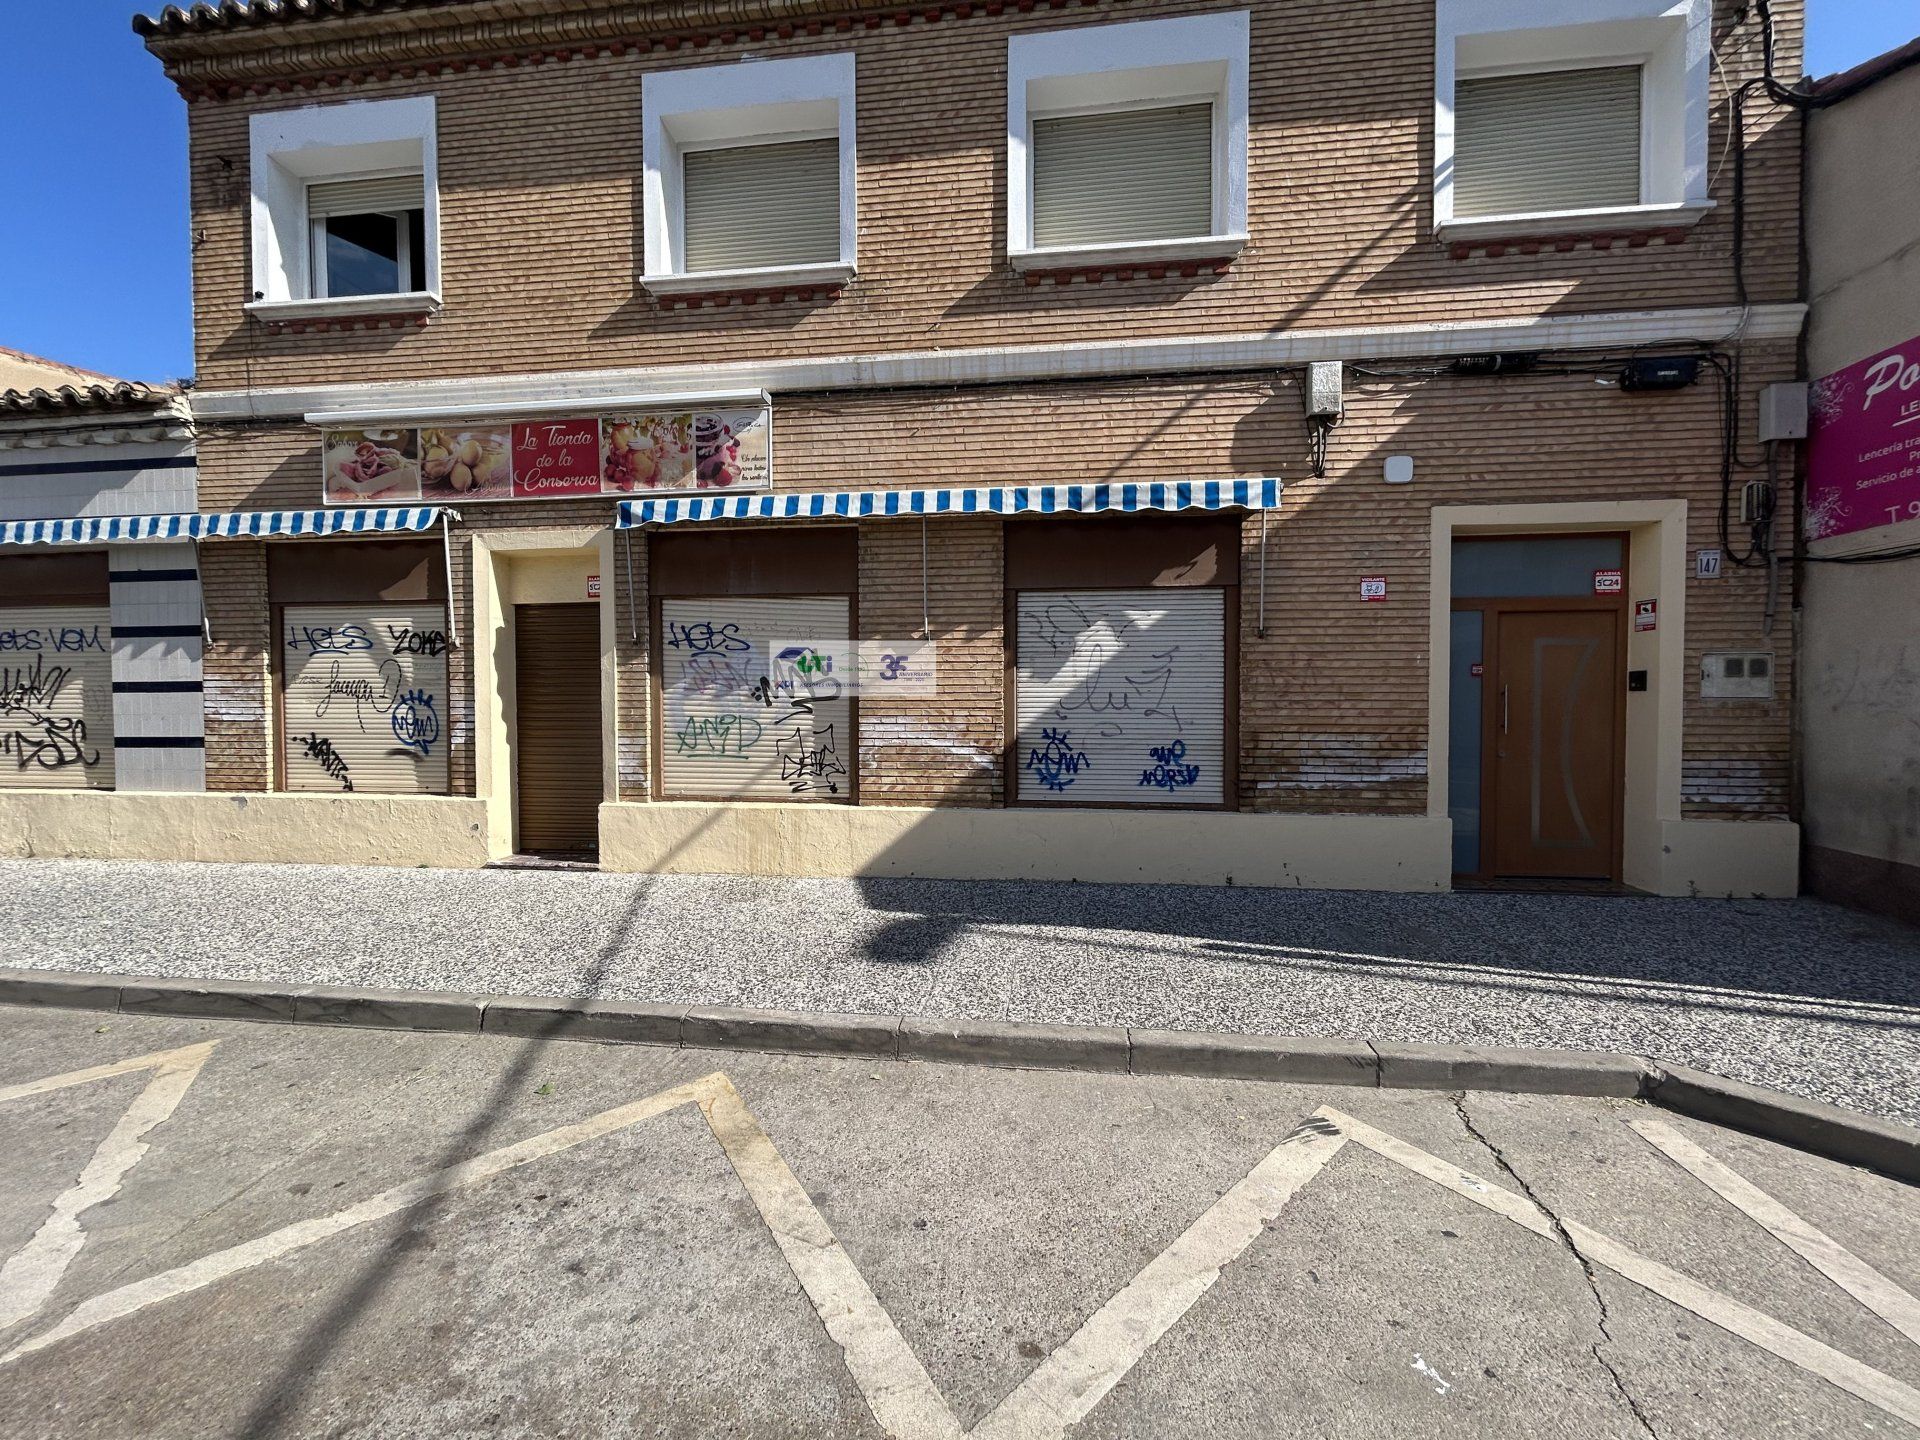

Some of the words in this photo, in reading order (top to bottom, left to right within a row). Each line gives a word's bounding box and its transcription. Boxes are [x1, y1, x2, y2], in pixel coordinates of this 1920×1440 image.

[516, 427, 538, 451] La
[541, 425, 593, 447] Tienda
[536, 454, 555, 468] de
[558, 448, 574, 467] la
[514, 468, 600, 491] Conserva
[1856, 473, 1897, 490] Servicio
[1900, 467, 1913, 478] de
[1699, 557, 1718, 573] 147
